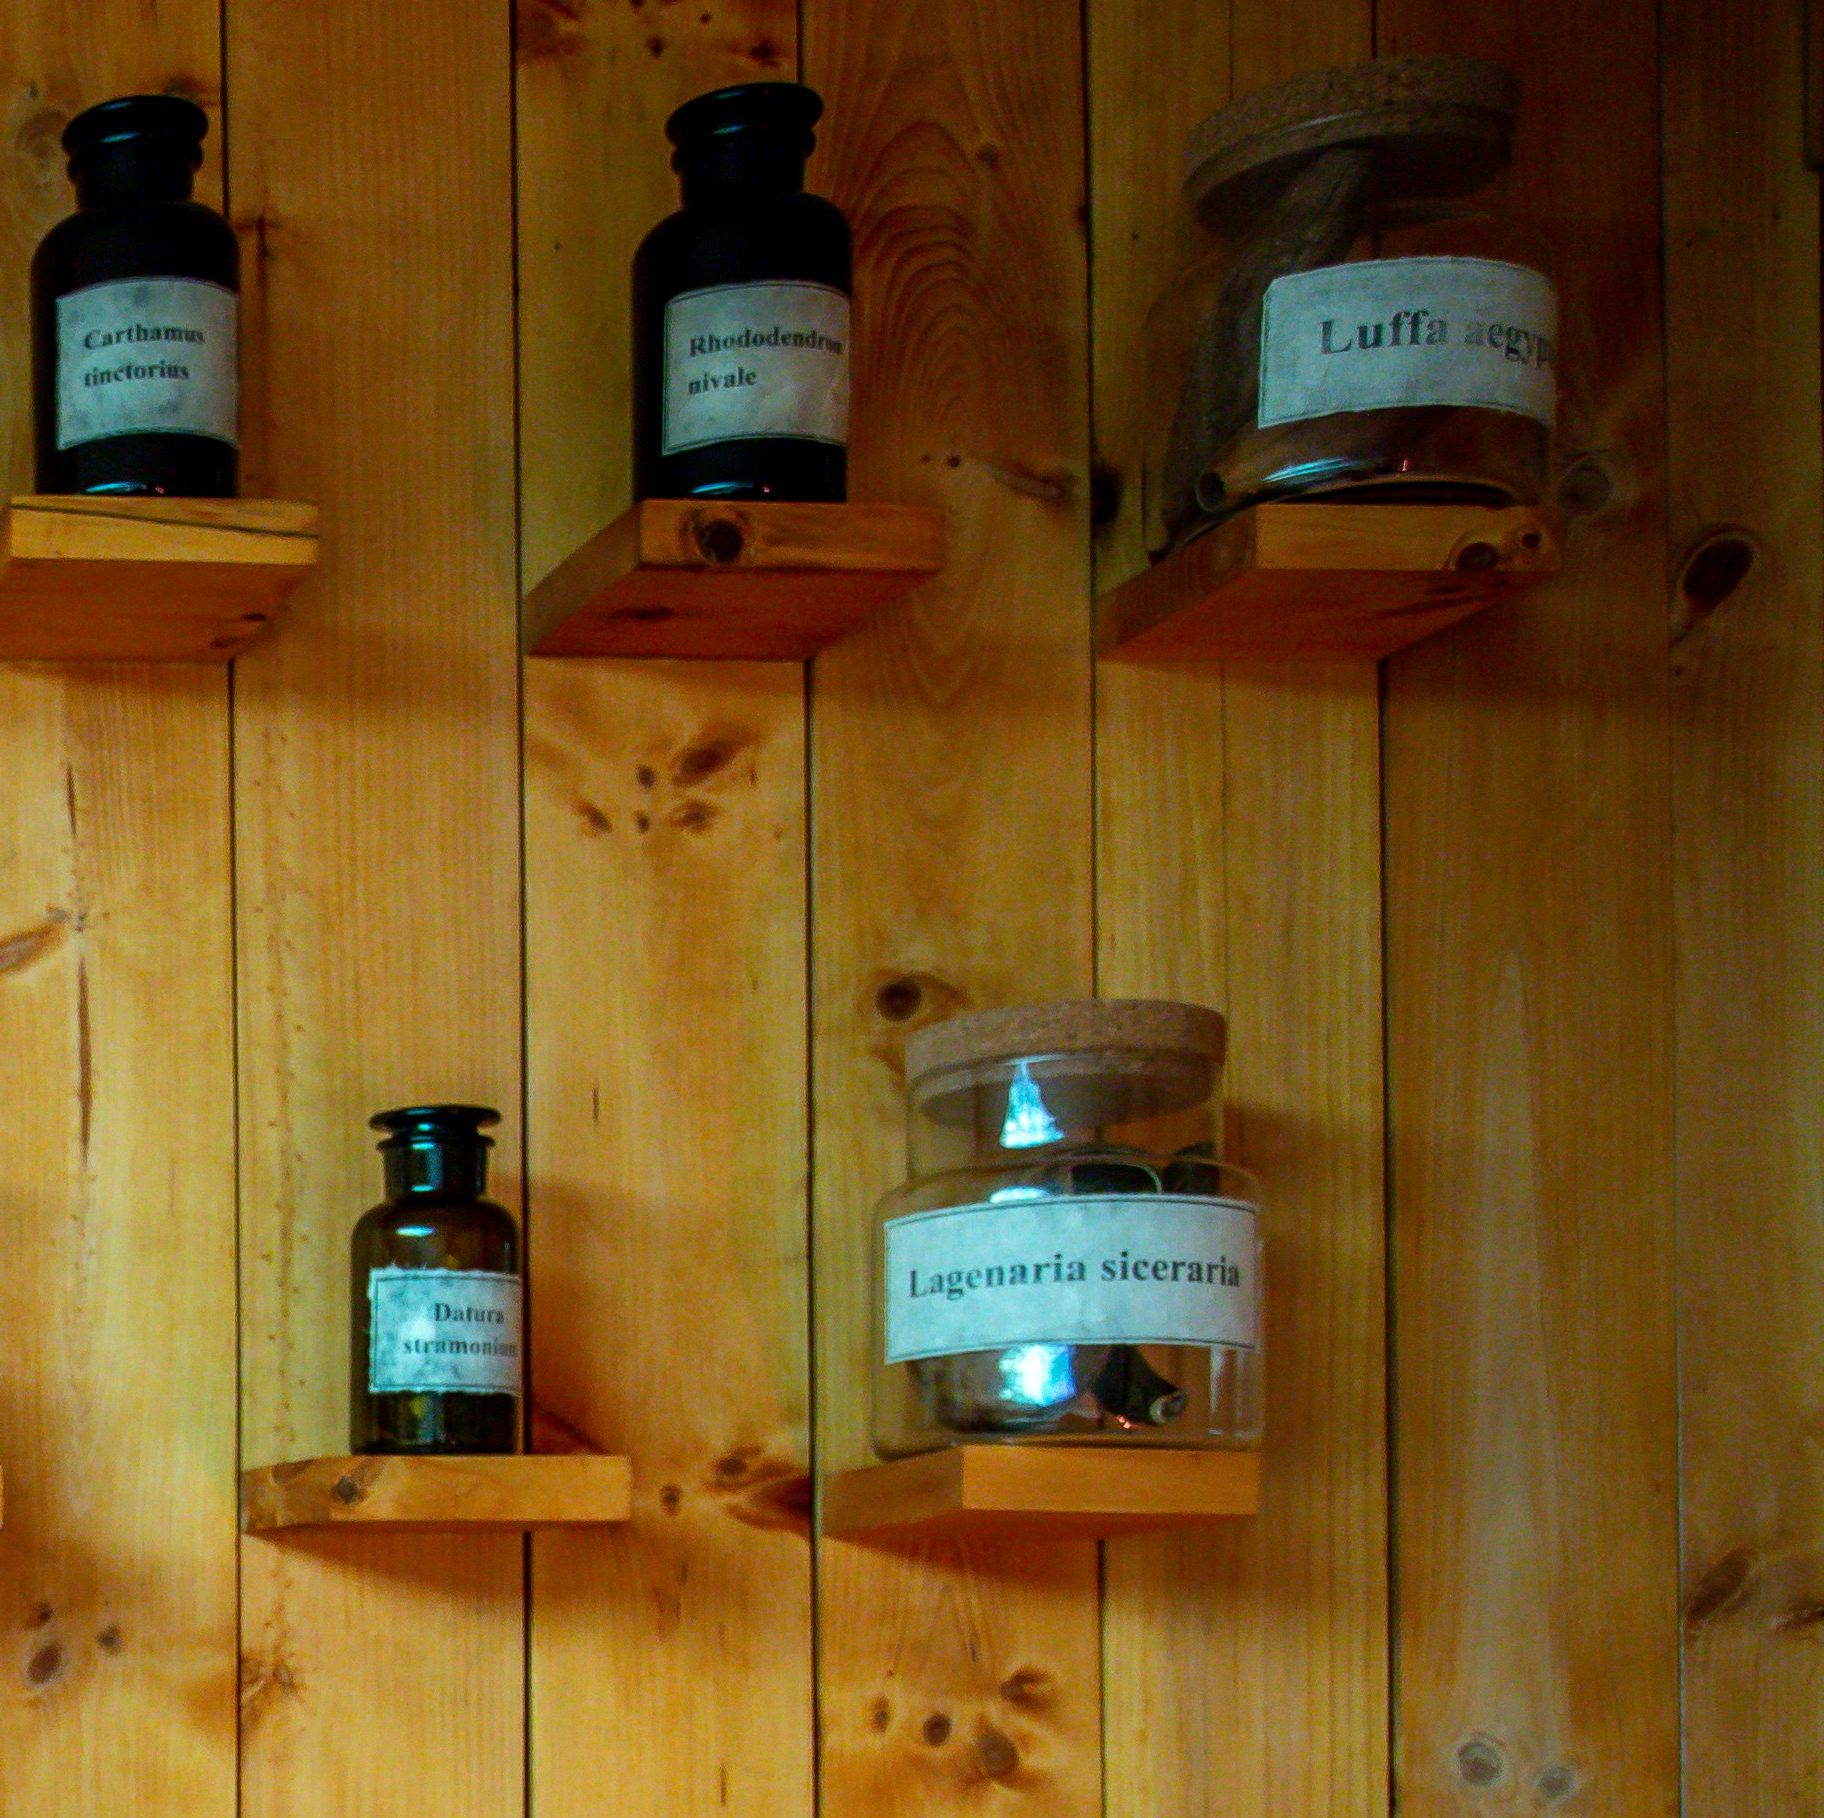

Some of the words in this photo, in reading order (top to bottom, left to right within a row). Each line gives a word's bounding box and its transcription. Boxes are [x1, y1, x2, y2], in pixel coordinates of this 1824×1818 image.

[83, 323, 206, 350] Carthamus
[1319, 308, 1449, 355] Luffa
[83, 361, 190, 387] tinctorius
[688, 367, 758, 395] nivale
[908, 1253, 1086, 1300] Lagenaria
[1100, 1250, 1240, 1288] siceraria
[435, 1303, 504, 1324] Datura
